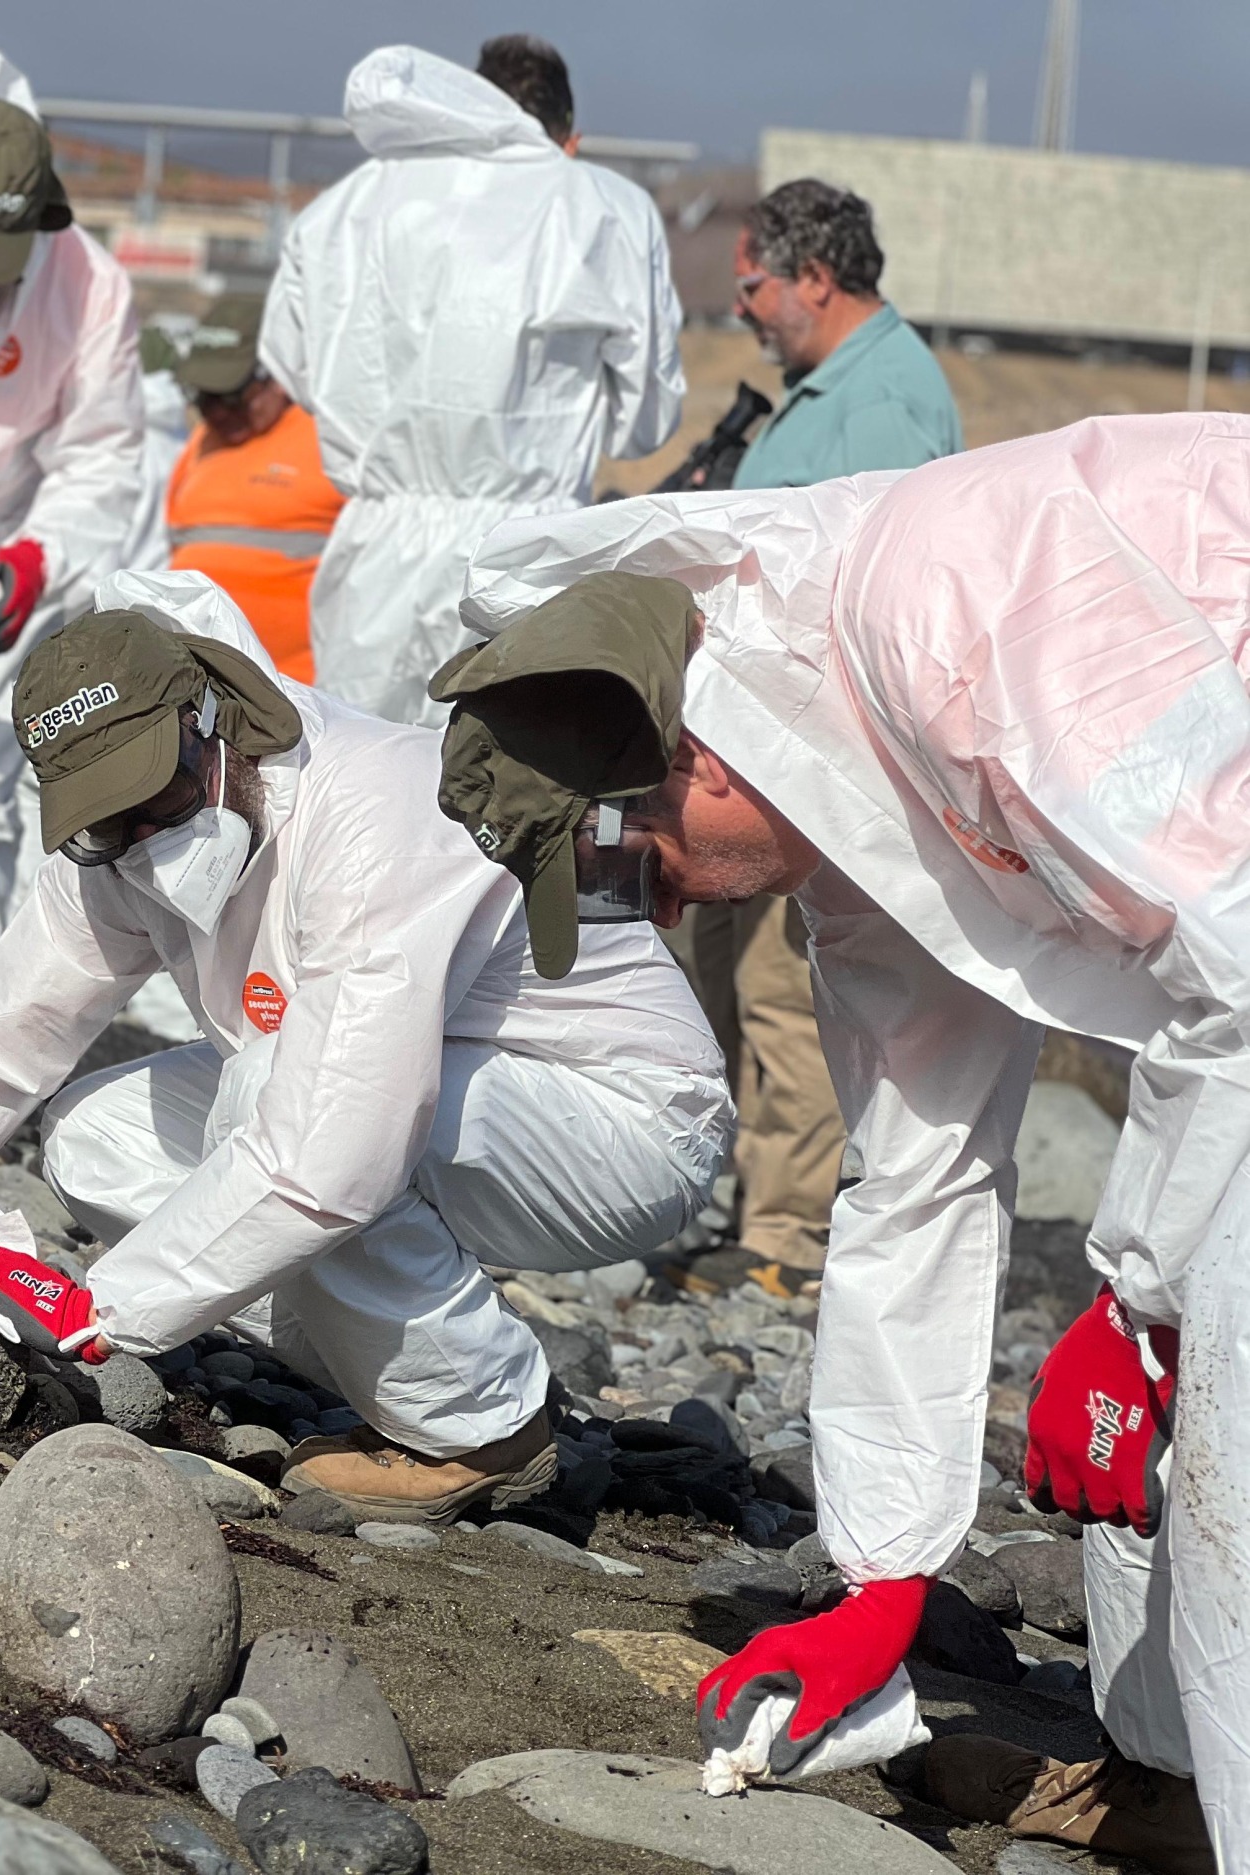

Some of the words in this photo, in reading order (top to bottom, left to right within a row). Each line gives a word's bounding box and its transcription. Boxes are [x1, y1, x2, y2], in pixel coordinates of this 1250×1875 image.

[41, 684, 117, 737] gesplan
[260, 1011, 280, 1021] plus
[9, 1270, 63, 1300] NINJA
[36, 1300, 55, 1313] FLEX
[1088, 1392, 1122, 1470] NINJA
[1128, 1406, 1142, 1430] FLEX
